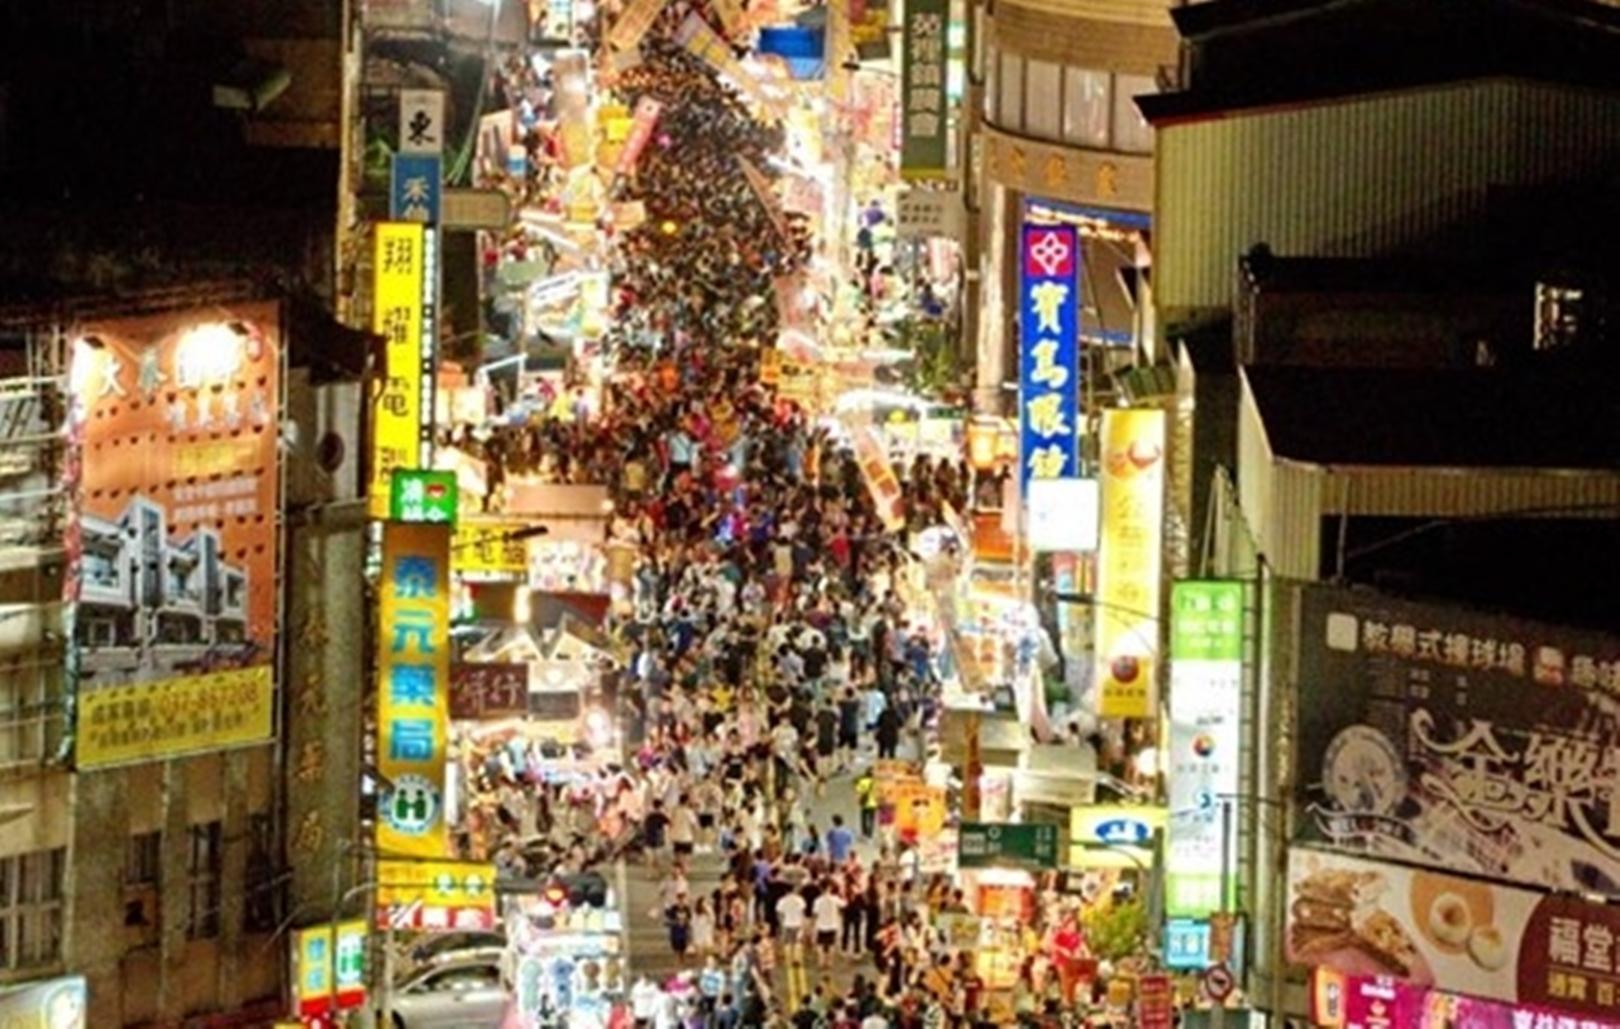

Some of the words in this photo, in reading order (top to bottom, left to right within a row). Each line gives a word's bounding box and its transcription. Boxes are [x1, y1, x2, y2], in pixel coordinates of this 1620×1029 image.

[1029, 281, 1072, 479] 寶島眼鏡
[391, 555, 438, 762] 泰元藥局
[1548, 917, 1620, 973] 福堂
